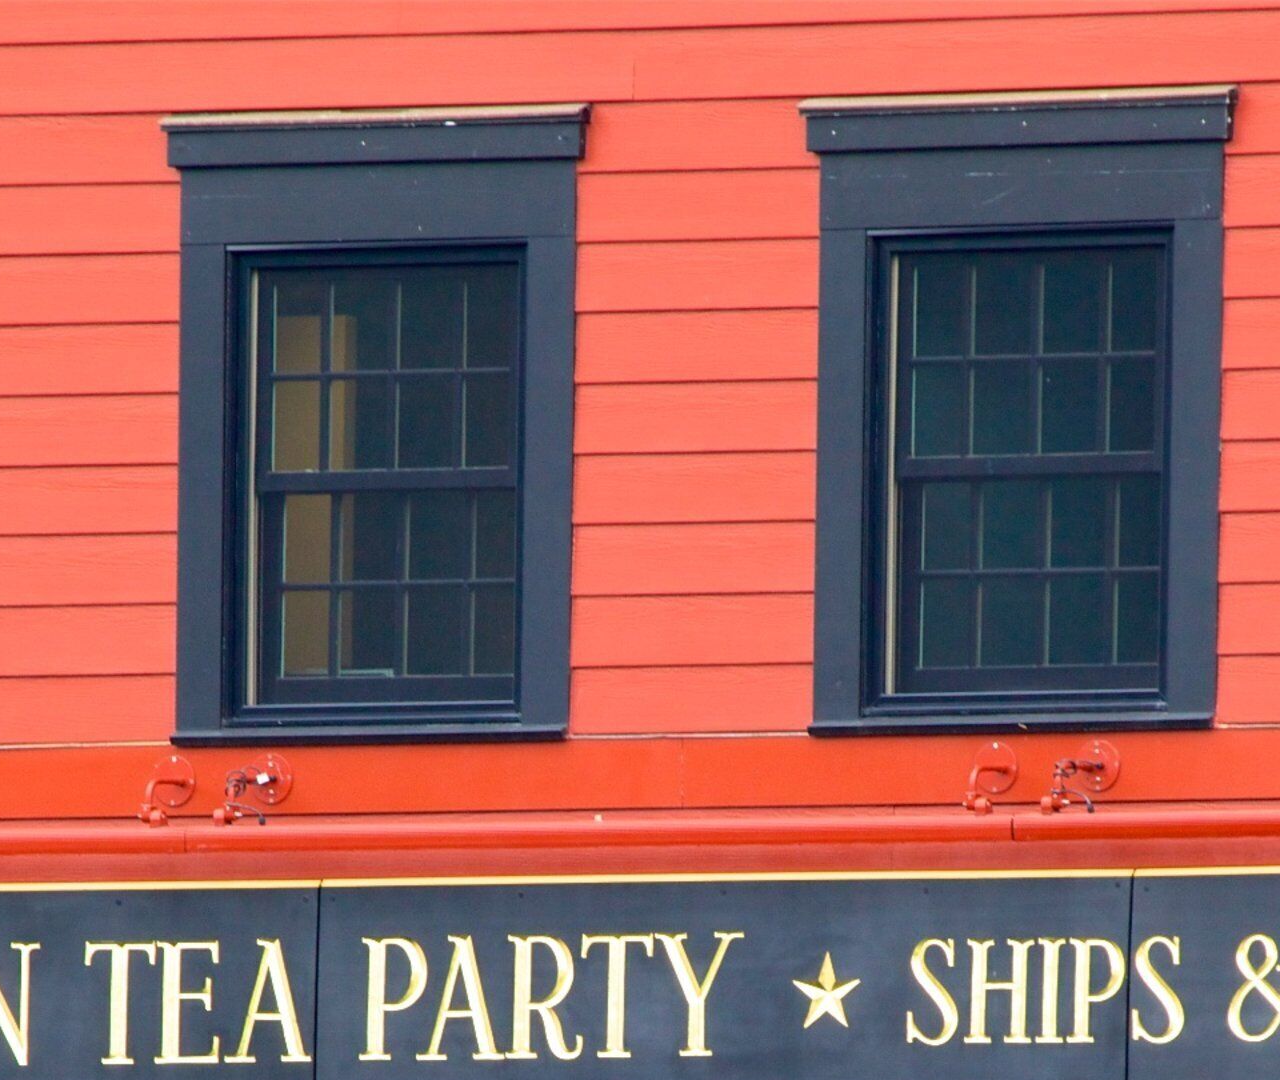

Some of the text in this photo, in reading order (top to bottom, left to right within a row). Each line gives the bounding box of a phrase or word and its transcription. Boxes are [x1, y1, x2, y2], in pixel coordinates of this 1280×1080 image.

[84, 937, 313, 1066] TEA
[358, 931, 745, 1062] PARTY
[904, 934, 1186, 1047] SHIPS
